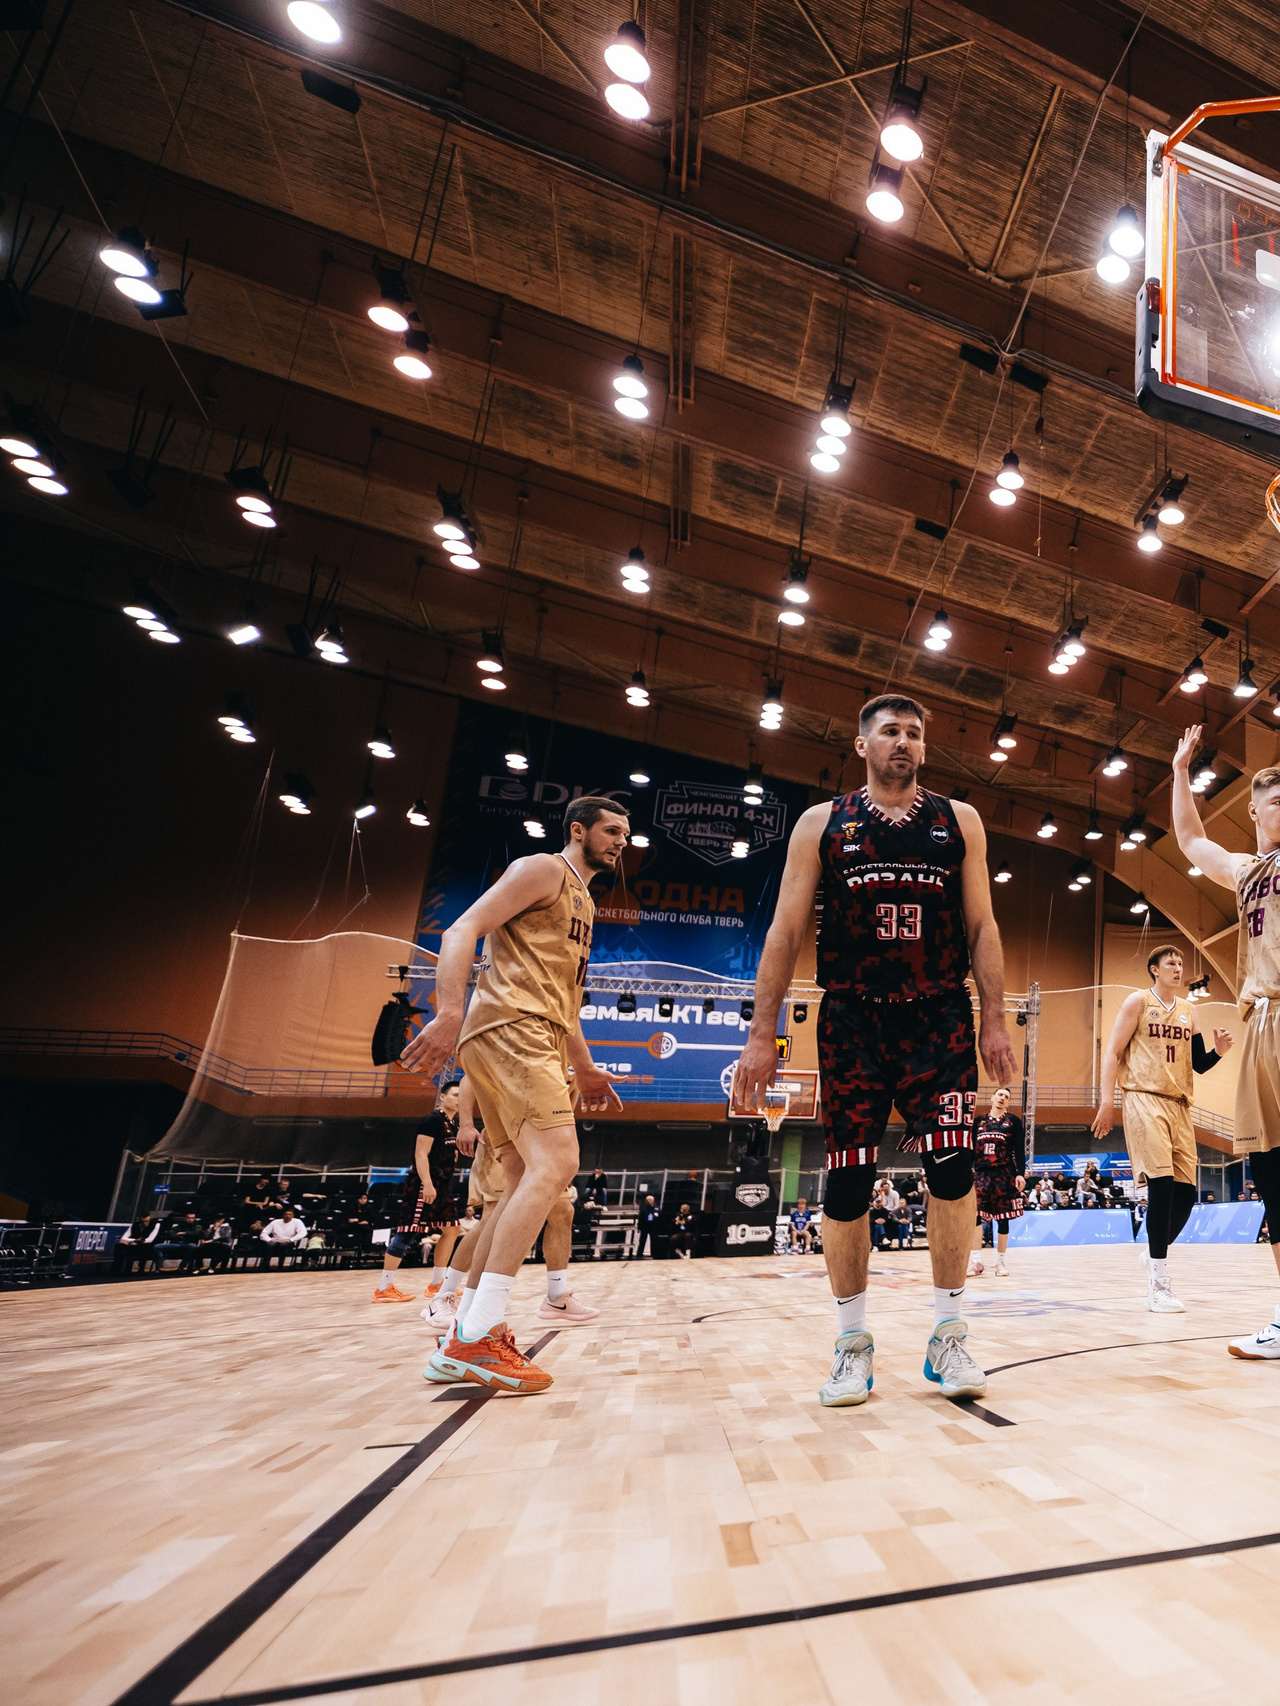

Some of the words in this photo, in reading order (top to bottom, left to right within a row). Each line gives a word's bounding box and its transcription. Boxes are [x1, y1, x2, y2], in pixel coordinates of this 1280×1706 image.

[689, 790, 738, 801] ЧЕМПИОНАТ
[478, 804, 562, 820] Титульй
[666, 802, 739, 818] ФИНАЛ
[687, 837, 720, 847] ТВЕРЬ
[846, 872, 944, 893] РЯЗАНЬ
[634, 880, 745, 913] ОДНА
[594, 907, 677, 923] СКЕТБОЛЬНОГО
[679, 913, 712, 925] КЛУБА
[714, 916, 744, 928] ТВЕРЬ
[876, 903, 922, 940] 33
[1148, 1023, 1191, 1041] ЦИВС
[1165, 1045, 1175, 1063] 11
[595, 1062, 632, 1073] 018
[938, 1091, 978, 1126] 33
[983, 1143, 996, 1155] 12
[1011, 1198, 1023, 1211] 12
[727, 1224, 749, 1245] 10
